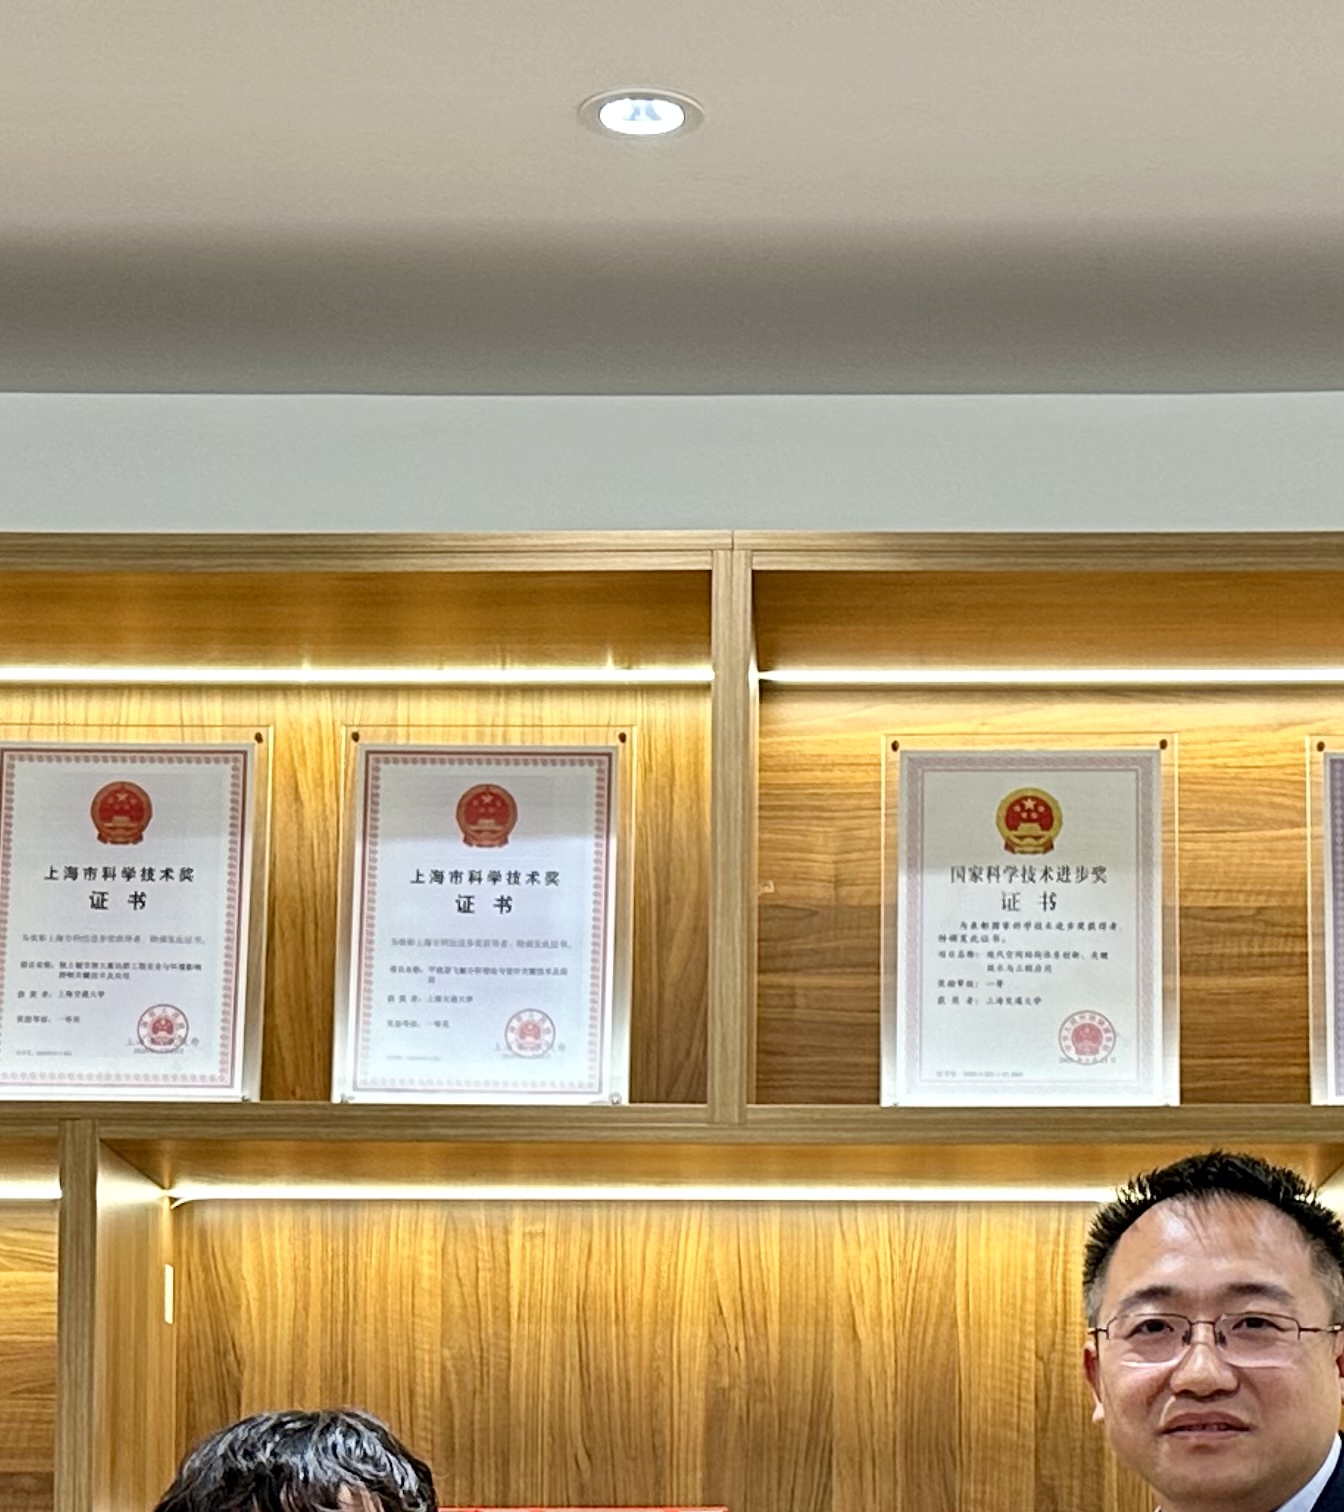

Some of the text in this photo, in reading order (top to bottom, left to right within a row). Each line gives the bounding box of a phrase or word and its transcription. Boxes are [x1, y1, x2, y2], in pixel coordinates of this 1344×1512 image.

[43, 866, 195, 882] 上海市科学技术奖
[410, 870, 560, 886] 上海市科学技术奖
[950, 865, 1108, 884] 国家科学技术进步奖
[89, 891, 147, 911] 证书
[456, 894, 513, 914] 证书
[1001, 891, 1058, 912] 证书
